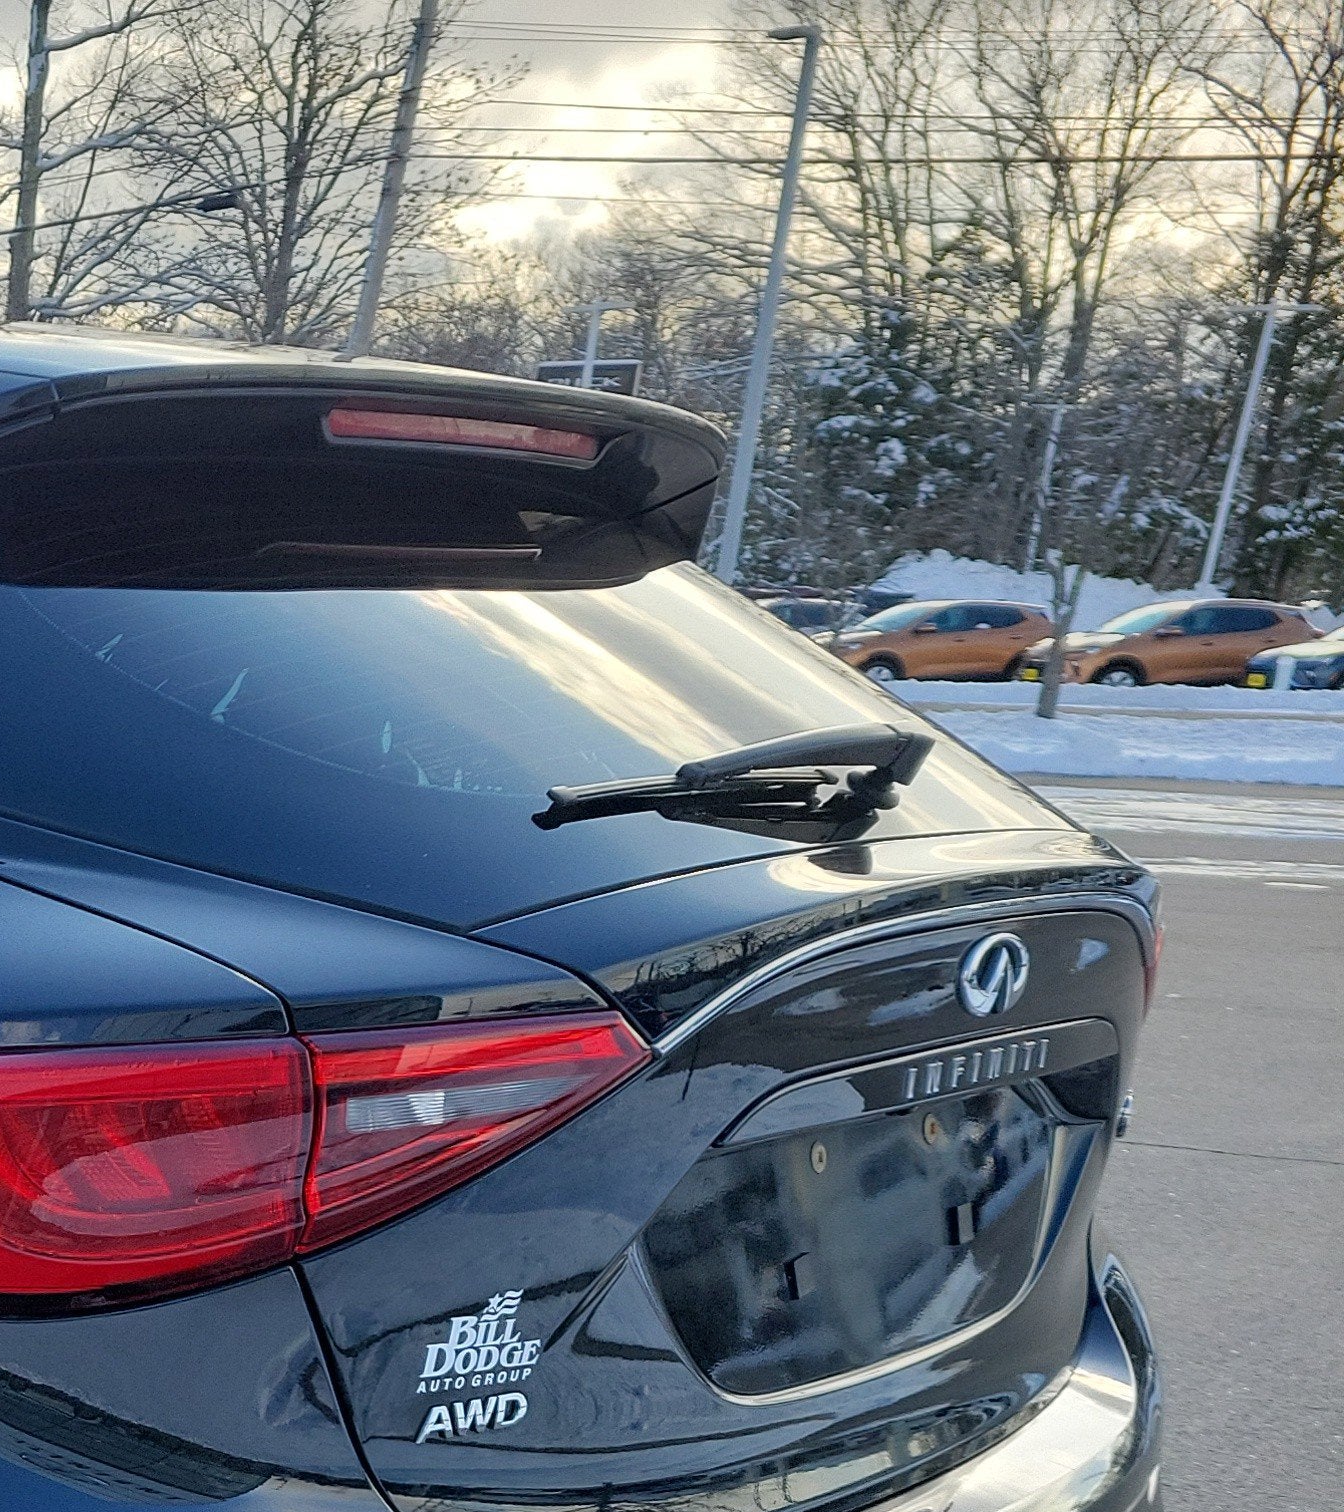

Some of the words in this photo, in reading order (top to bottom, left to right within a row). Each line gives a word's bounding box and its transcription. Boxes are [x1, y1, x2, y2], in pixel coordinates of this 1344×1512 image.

[905, 1038, 1050, 1100] INFINITI
[449, 1315, 522, 1348] BILL
[419, 1339, 543, 1379] DODGE
[416, 1376, 466, 1394] AUTO
[471, 1367, 533, 1387] GROUP
[415, 1391, 529, 1444] AWD
